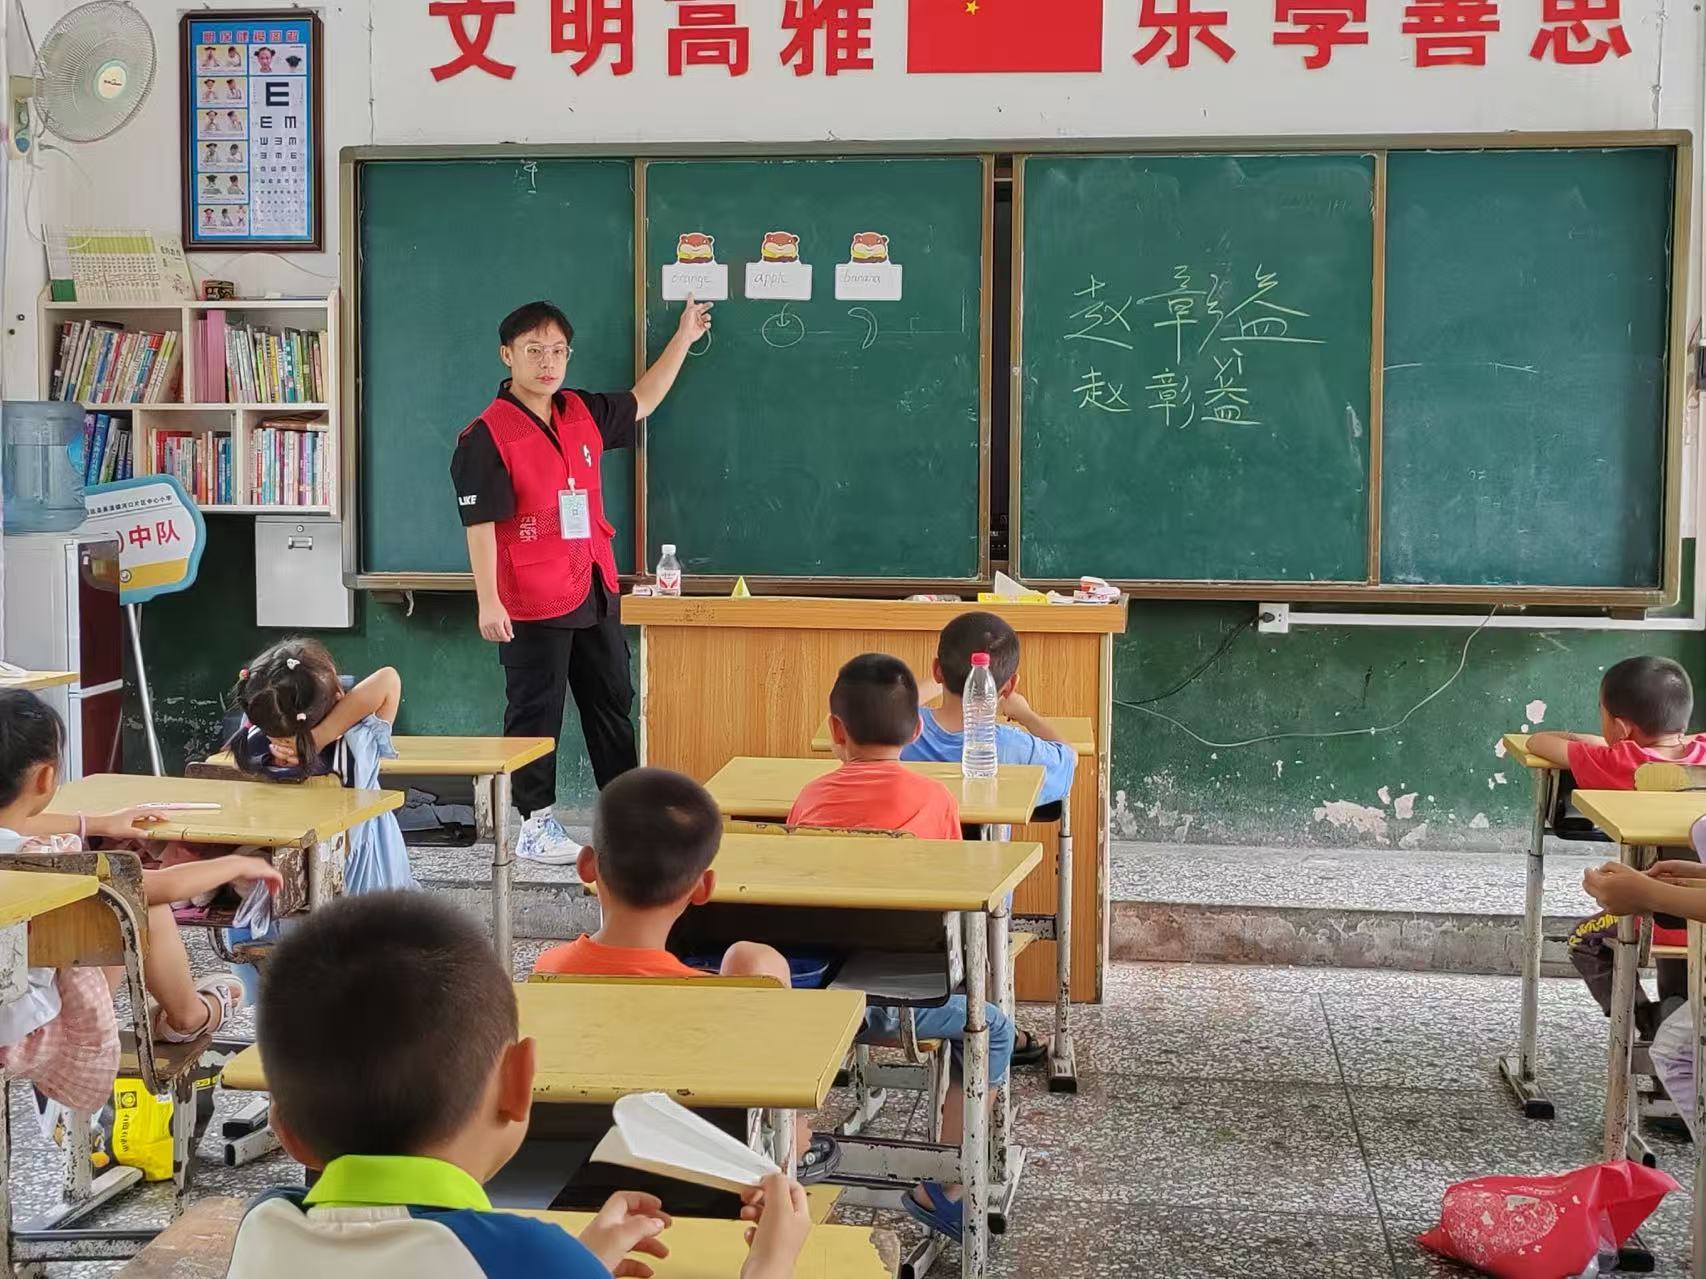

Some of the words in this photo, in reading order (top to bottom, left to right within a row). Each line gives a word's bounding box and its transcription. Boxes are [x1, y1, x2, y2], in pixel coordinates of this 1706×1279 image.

[428, 0, 874, 82] 文明高雅
[1132, 0, 1632, 70] 乐学善思
[753, 270, 789, 288] apple
[842, 270, 881, 283] banana
